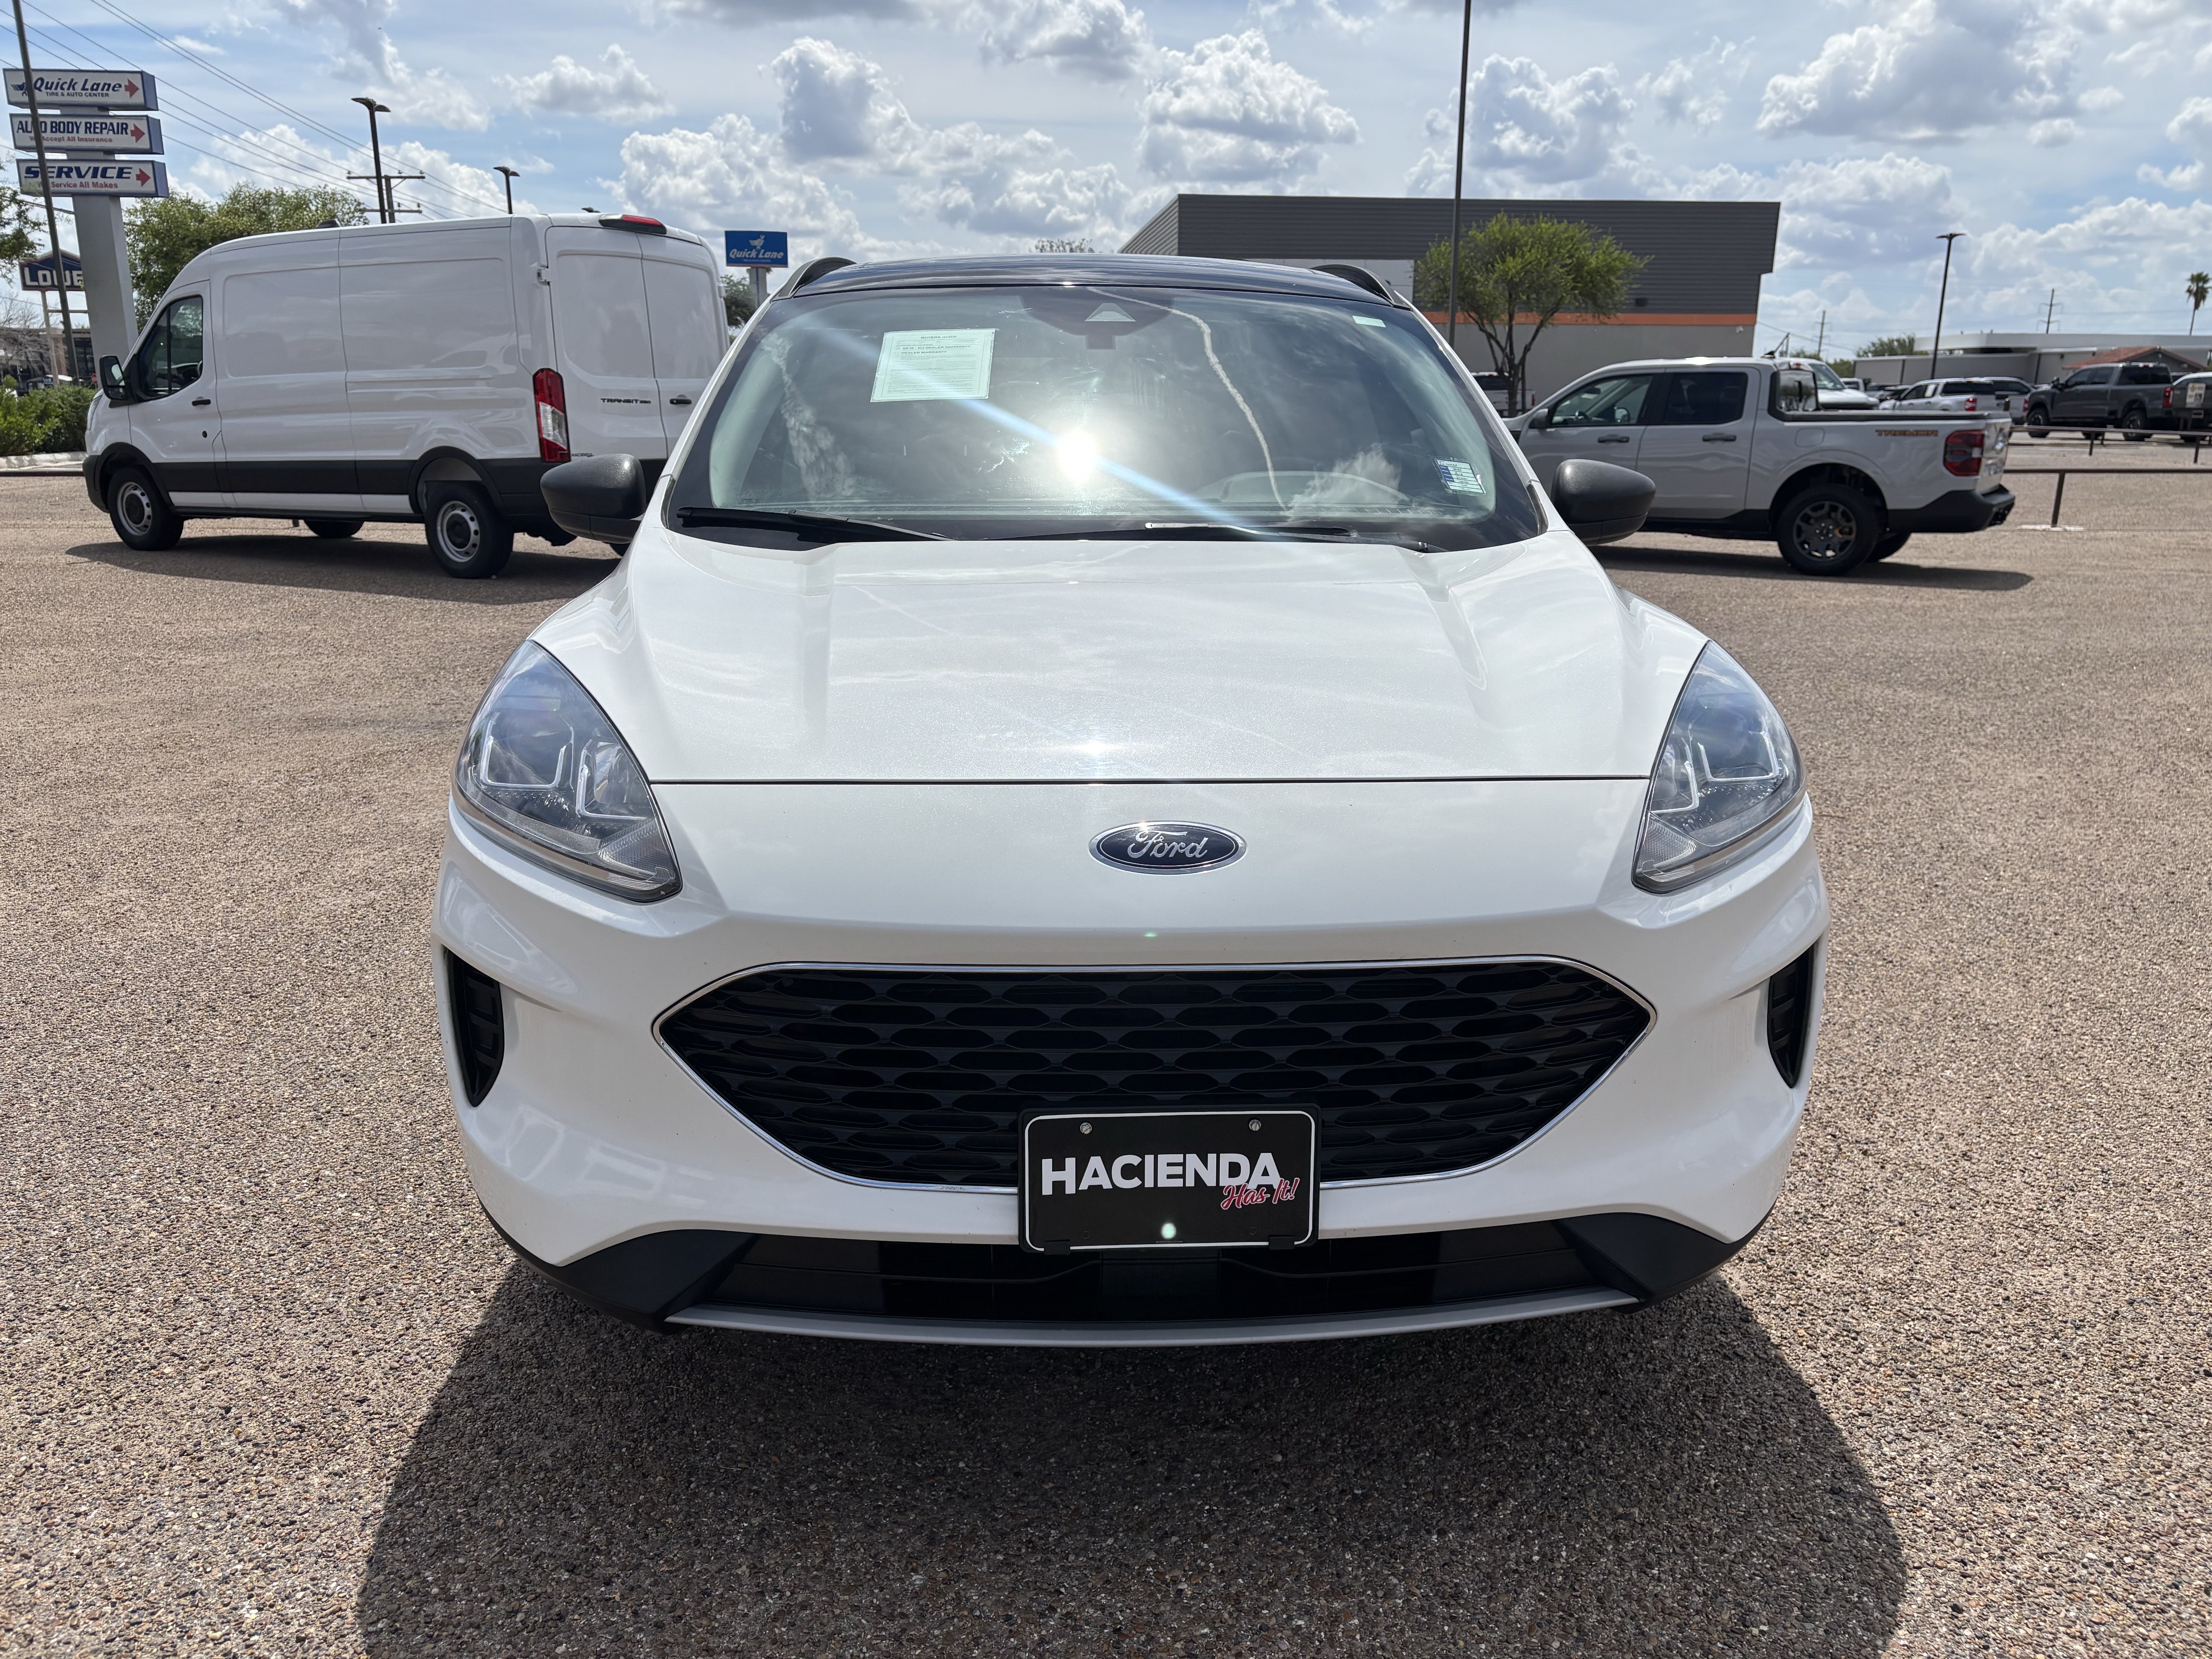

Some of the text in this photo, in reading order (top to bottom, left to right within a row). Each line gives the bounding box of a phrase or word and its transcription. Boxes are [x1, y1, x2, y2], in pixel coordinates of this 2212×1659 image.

[34, 77, 122, 92] Quick Lane
[17, 120, 128, 135] AUO BODY REPAIR
[24, 166, 132, 179] SERVICE
[729, 248, 784, 259] Quick Lane
[1875, 429, 1939, 437] TREMOR
[1127, 830, 1209, 859] Ford
[1041, 1152, 1281, 1195] HACIENDA
[1221, 1177, 1300, 1210] Has It!
